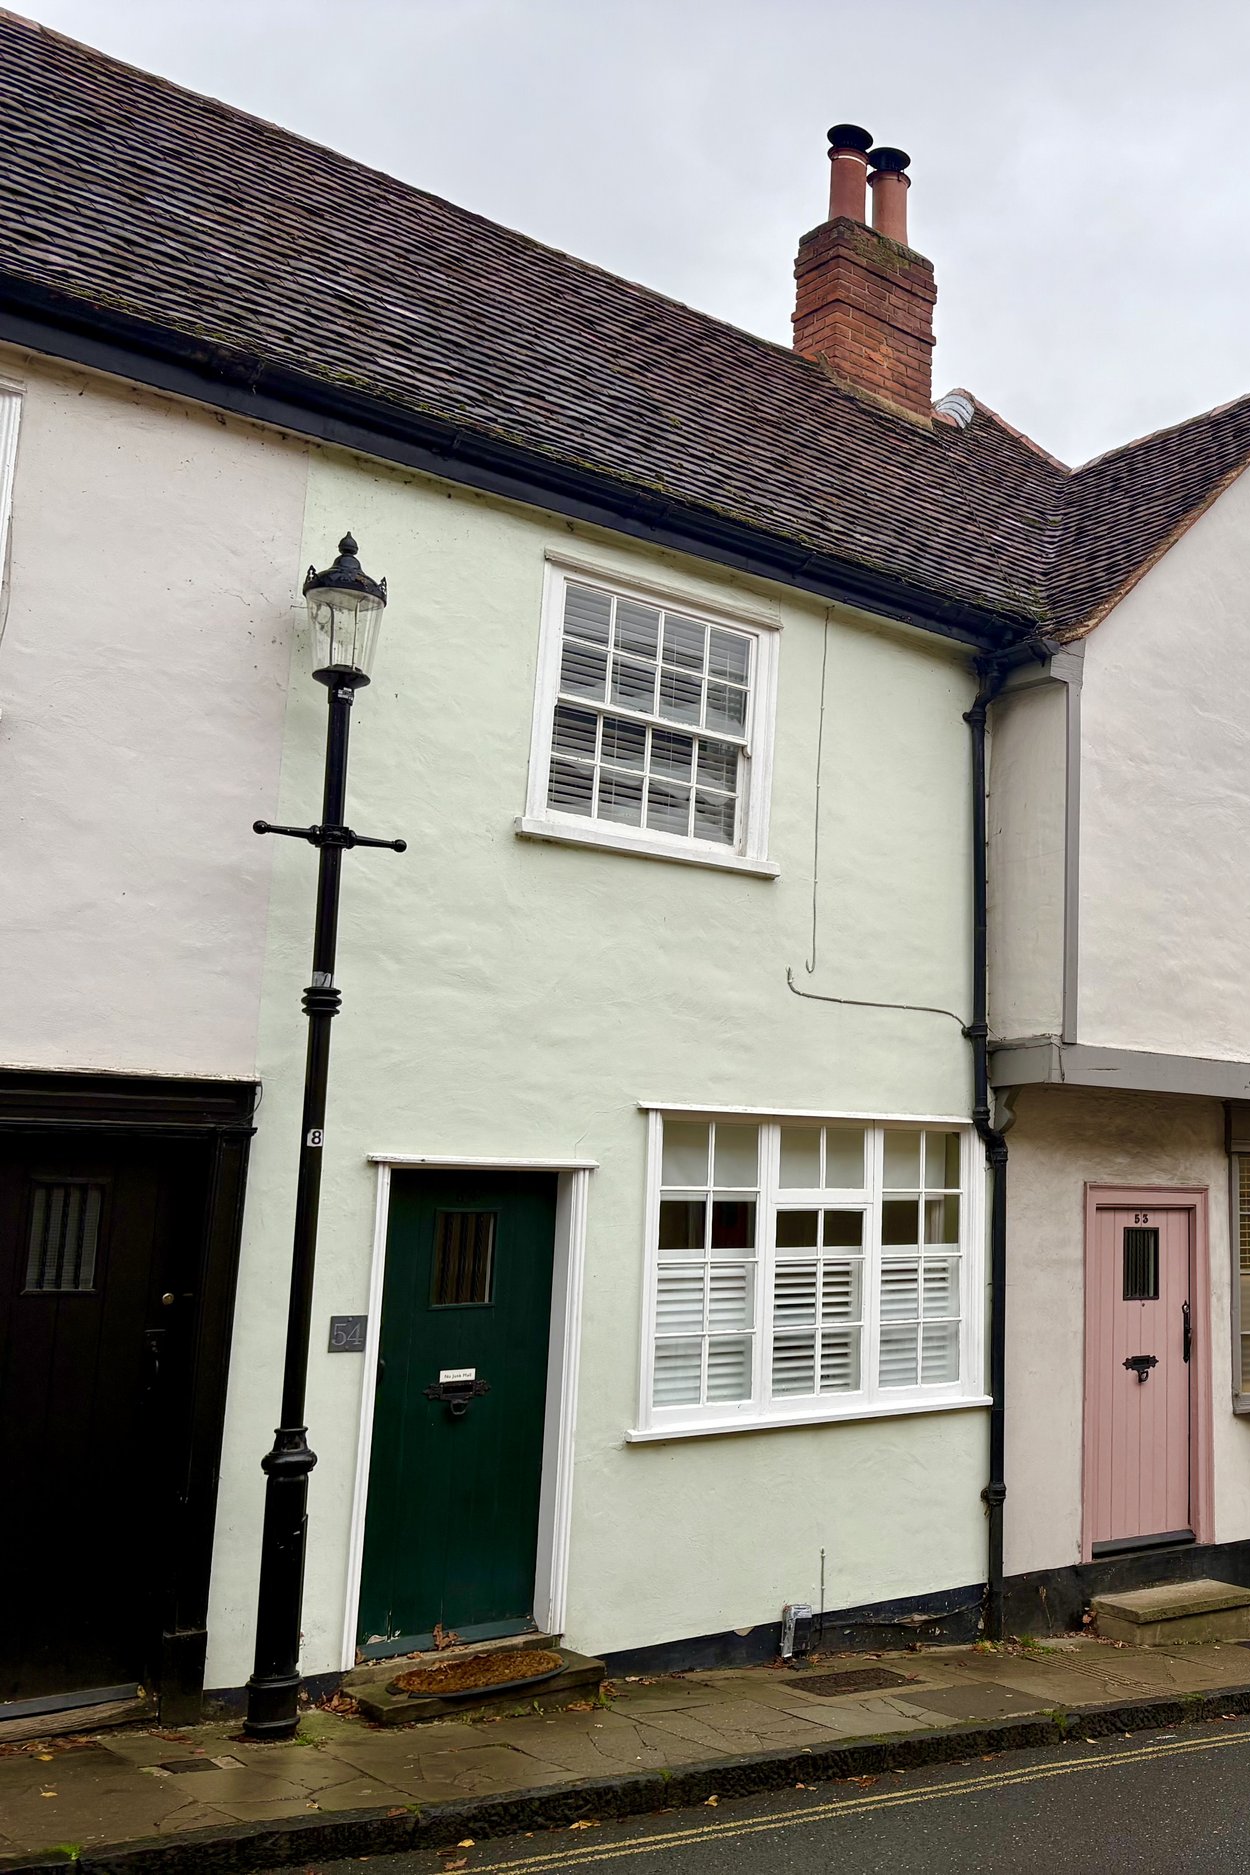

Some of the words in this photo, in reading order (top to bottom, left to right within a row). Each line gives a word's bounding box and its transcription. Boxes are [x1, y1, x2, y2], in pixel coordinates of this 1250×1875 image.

[311, 1130, 322, 1145] 8
[1134, 1213, 1149, 1224] 53
[331, 1323, 364, 1346] 54
